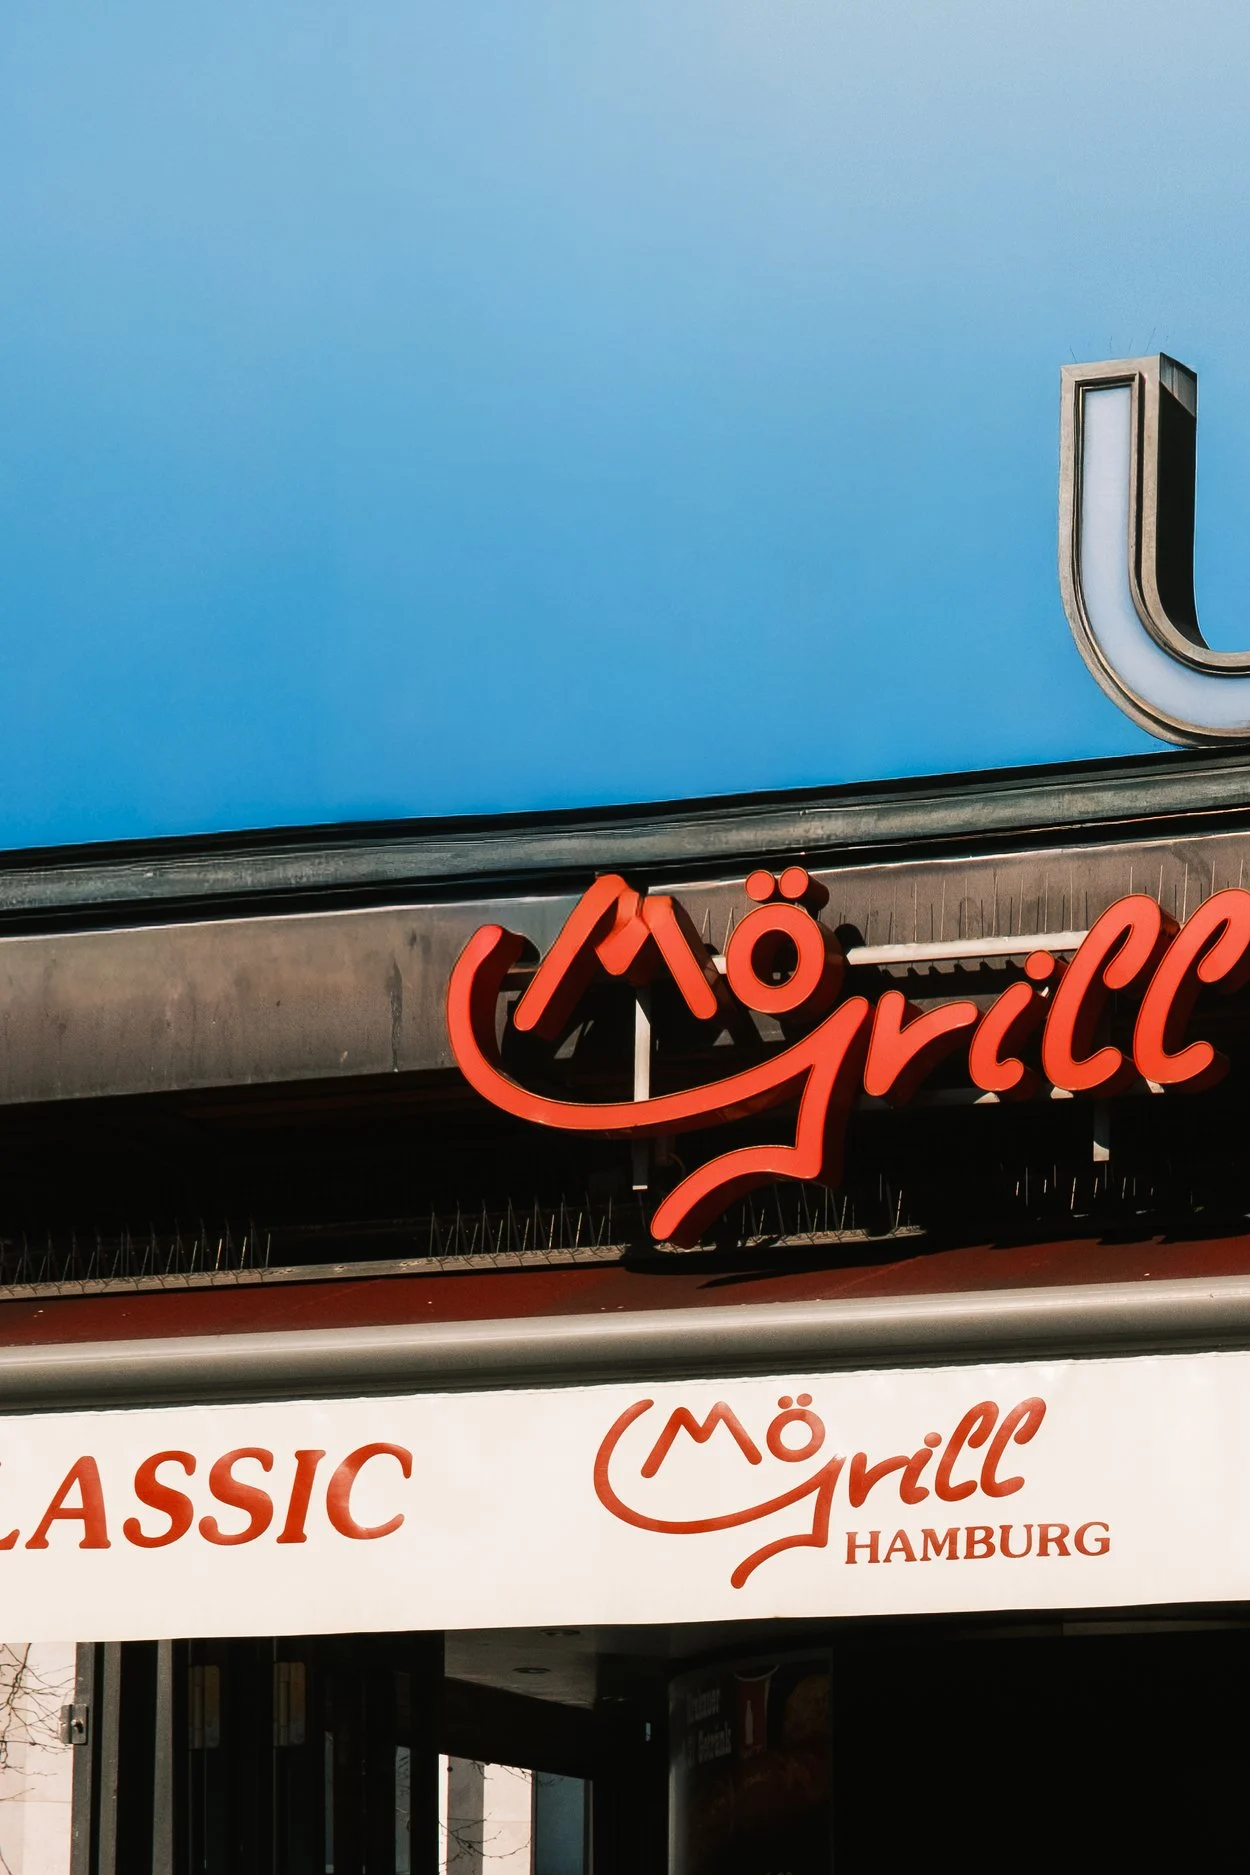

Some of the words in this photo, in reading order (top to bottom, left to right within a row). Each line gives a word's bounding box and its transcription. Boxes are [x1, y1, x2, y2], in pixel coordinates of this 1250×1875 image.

[513, 866, 828, 1032] Mö
[641, 1394, 826, 1484] Mö
[0, 1443, 412, 1551] ASSIC
[594, 1398, 1047, 1591] Grill
[846, 1521, 1111, 1567] HAMBURG
